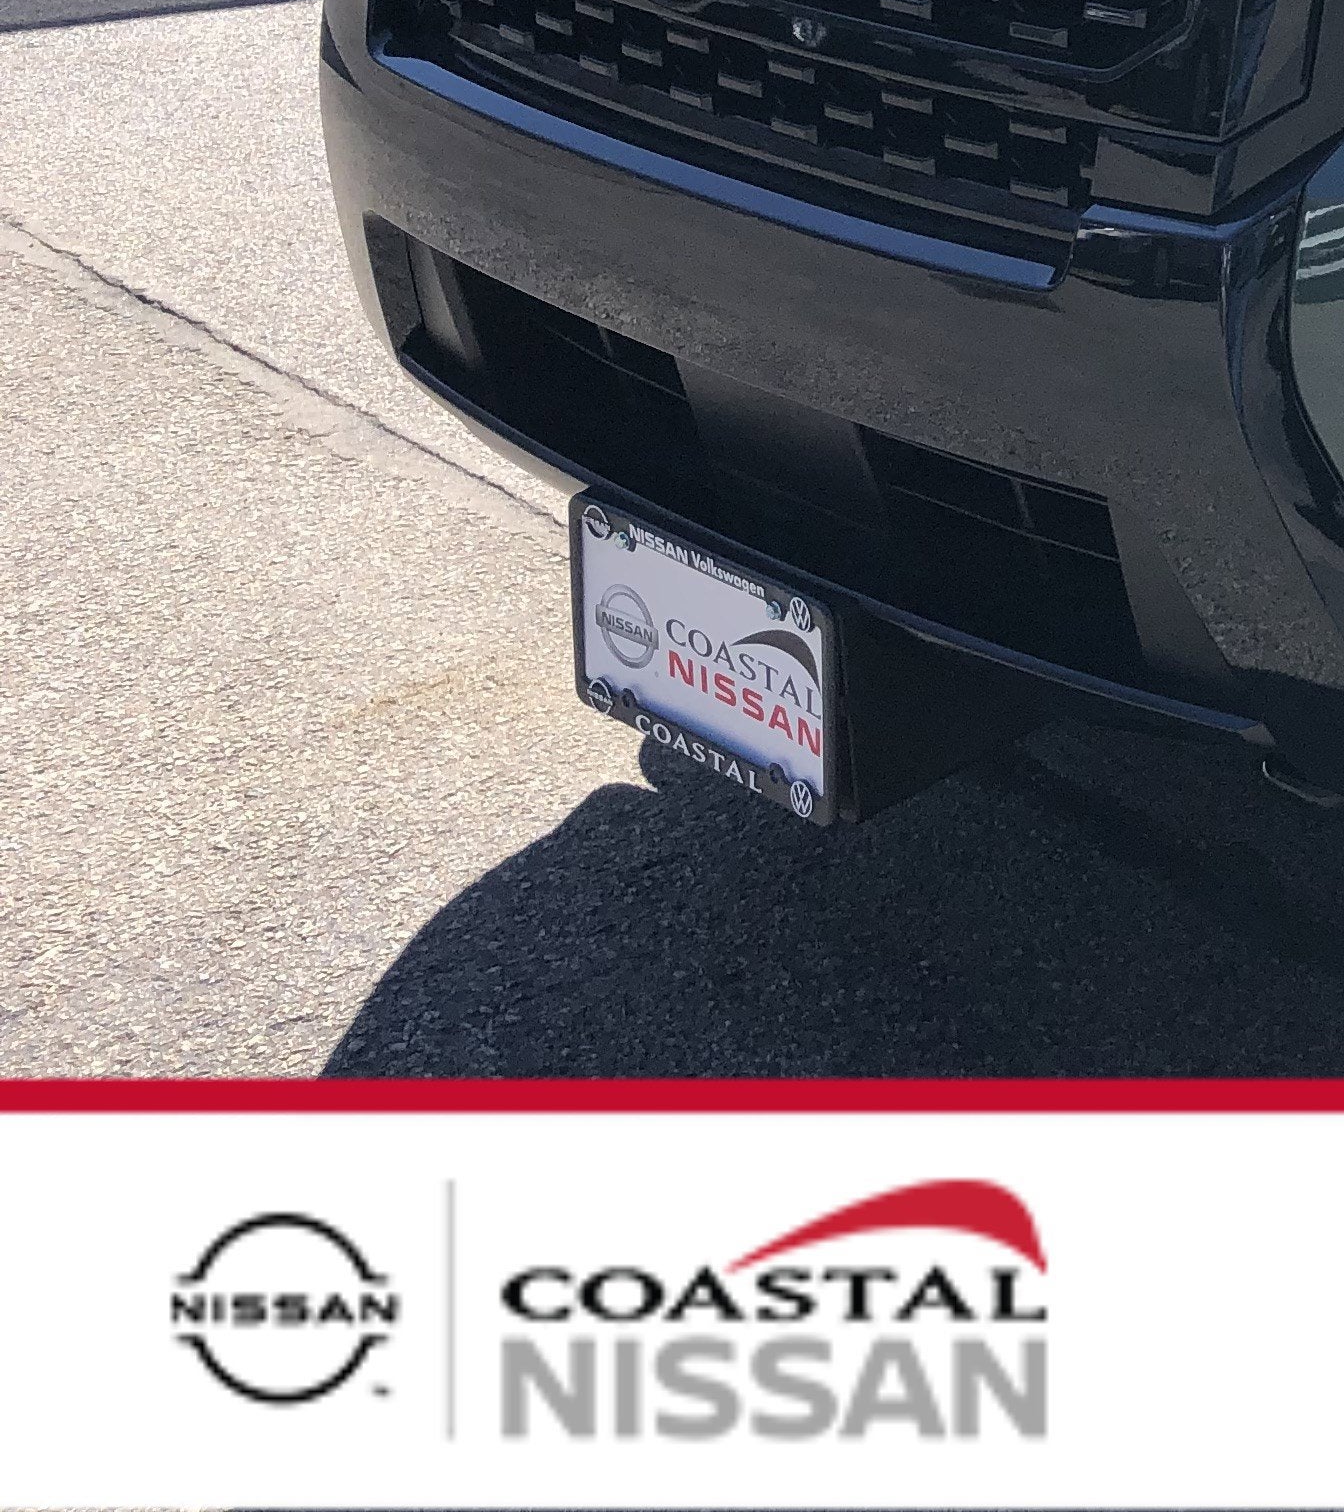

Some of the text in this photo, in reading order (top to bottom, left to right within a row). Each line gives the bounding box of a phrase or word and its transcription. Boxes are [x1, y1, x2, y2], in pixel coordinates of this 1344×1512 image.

[629, 524, 765, 598] NISSAN Volkswagen
[601, 611, 654, 644] NISSAN
[665, 618, 822, 720] COASTAL
[668, 649, 821, 758] NISSAN
[635, 715, 763, 794] COASTAL
